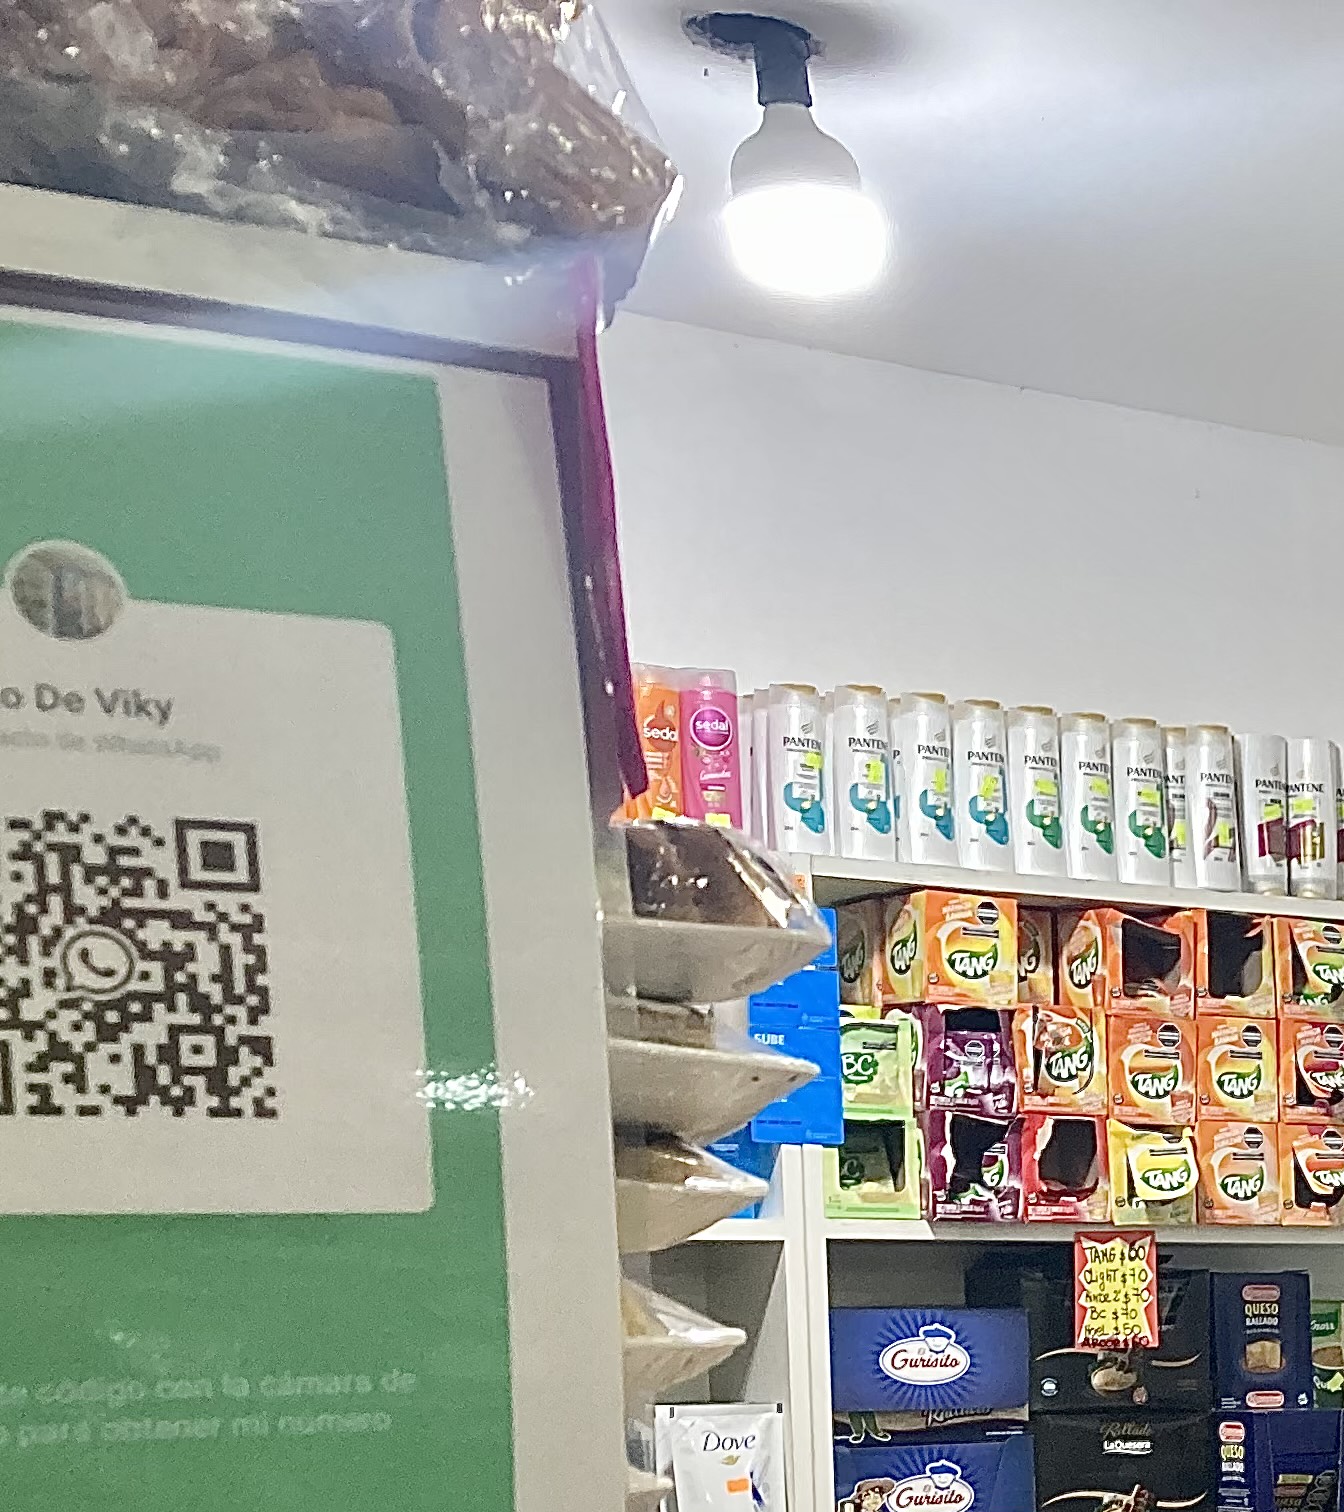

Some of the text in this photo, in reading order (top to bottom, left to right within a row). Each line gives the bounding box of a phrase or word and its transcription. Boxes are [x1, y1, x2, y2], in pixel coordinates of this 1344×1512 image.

[34, 682, 85, 713] De
[93, 687, 175, 730] Viky
[643, 728, 679, 741] seda
[695, 719, 730, 732] sedal
[782, 735, 822, 751] PANTEN
[916, 743, 950, 758] PANTE
[966, 750, 1005, 765] PANTEN
[892, 936, 916, 971] TANG
[951, 951, 995, 977] TANG
[1019, 948, 1038, 977] NG
[1070, 947, 1097, 985] TANG
[1299, 993, 1331, 1006] ANG
[1050, 1046, 1090, 1080] TANG
[1134, 1071, 1175, 1099] TANG
[1218, 1072, 1259, 1097] TANG
[1146, 1169, 1189, 1190] TANG
[1221, 1177, 1263, 1201] TANG
[1083, 1245, 1116, 1265] TANG
[1244, 1303, 1279, 1317] QUESO
[890, 1349, 961, 1371] Gurisito
[701, 1430, 756, 1452] Dove
[895, 1486, 965, 1509] Gurisito
